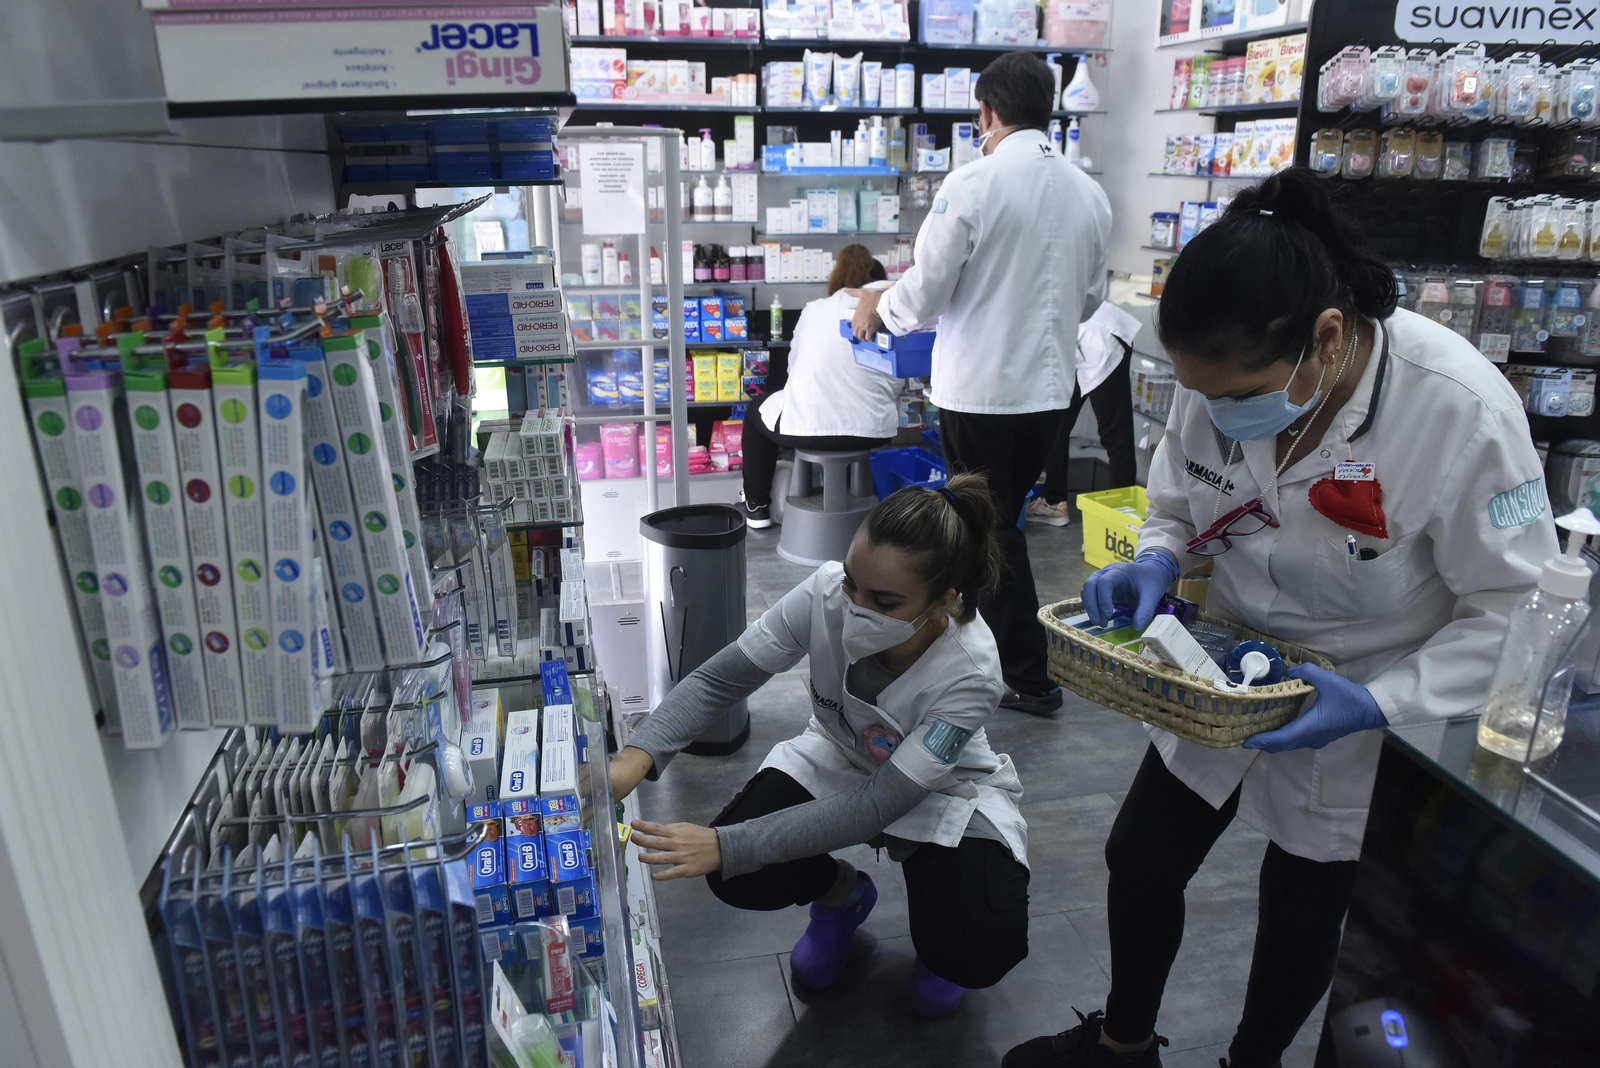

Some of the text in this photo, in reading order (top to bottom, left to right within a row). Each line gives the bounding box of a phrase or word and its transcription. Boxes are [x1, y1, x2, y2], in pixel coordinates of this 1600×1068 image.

[420, 23, 540, 57] Lacer
[1248, 48, 1270, 60] Blevit
[1280, 42, 1304, 56] Blevit
[445, 50, 541, 85] Gingi
[1194, 86, 1202, 98] 3
[380, 242, 406, 252] Lacer
[512, 300, 554, 309] PERIO-AID
[684, 300, 698, 308] vax
[516, 322, 558, 331] PERIO-AID
[684, 321, 699, 329] vax
[725, 319, 747, 327] evax
[518, 344, 561, 352] PERIO-AID
[1493, 480, 1544, 526] CANSINO
[472, 739, 482, 755] Oral-B
[512, 772, 524, 791] Oral-B
[522, 844, 534, 868] Oral-B
[564, 843, 575, 867] Oral-B
[481, 850, 492, 874] Oral-B
[636, 962, 648, 988] COREGA
[550, 998, 572, 1006] recambio
